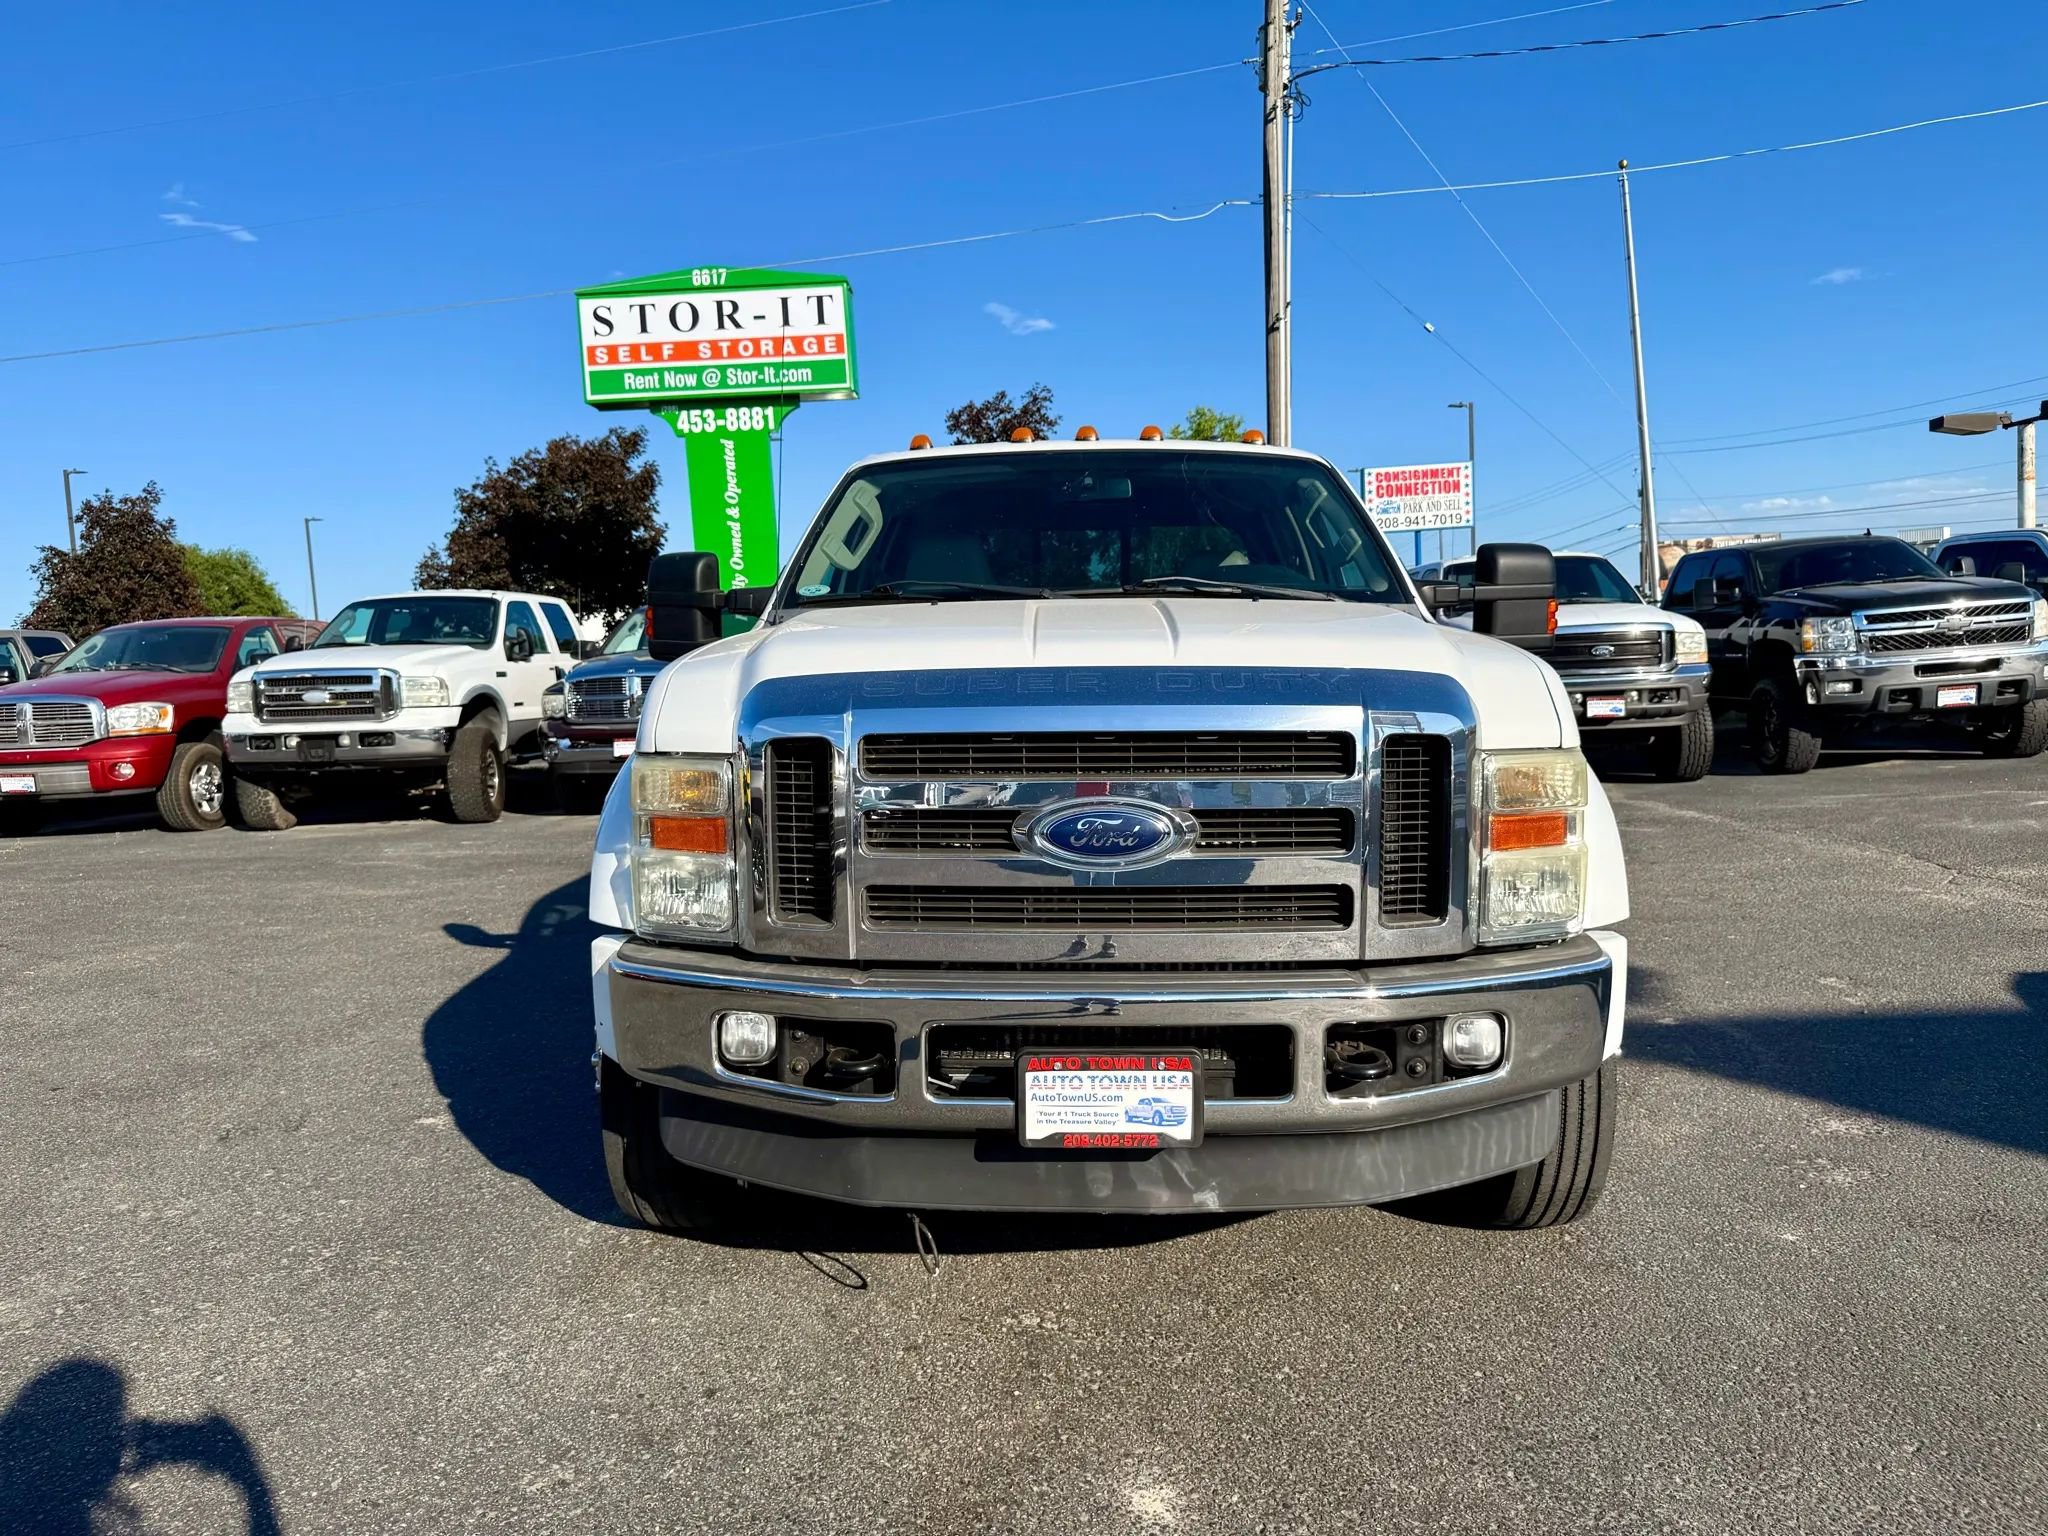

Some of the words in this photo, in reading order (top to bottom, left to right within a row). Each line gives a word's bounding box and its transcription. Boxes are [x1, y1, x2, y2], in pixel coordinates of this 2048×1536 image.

[692, 269, 728, 287] 6617
[592, 294, 834, 337] STOR-IT
[595, 344, 674, 364] SELF
[698, 336, 838, 359] STORAGE
[624, 372, 660, 390] Rent
[664, 371, 697, 388] Now
[702, 368, 721, 388] @
[726, 366, 812, 386] Stor-It.com
[677, 407, 775, 433] 453-8881
[720, 438, 742, 505] Operated
[1375, 467, 1461, 483] CONSIGNMENT
[1375, 480, 1461, 498] CONNECTION
[1403, 502, 1423, 514] PARK
[1426, 501, 1441, 512] AND
[1444, 499, 1462, 511] SELL
[1377, 513, 1462, 529] 208-941-7019
[727, 520, 744, 571] Owned
[861, 672, 1109, 697] SUPER
[1158, 671, 1351, 693] DUTY
[1070, 818, 1141, 847] Ford
[1027, 1057, 1080, 1070] AUTO
[1086, 1057, 1145, 1070] TOWN
[1151, 1057, 1192, 1070] USA
[1031, 1093, 1123, 1103] AutoTownUS.com
